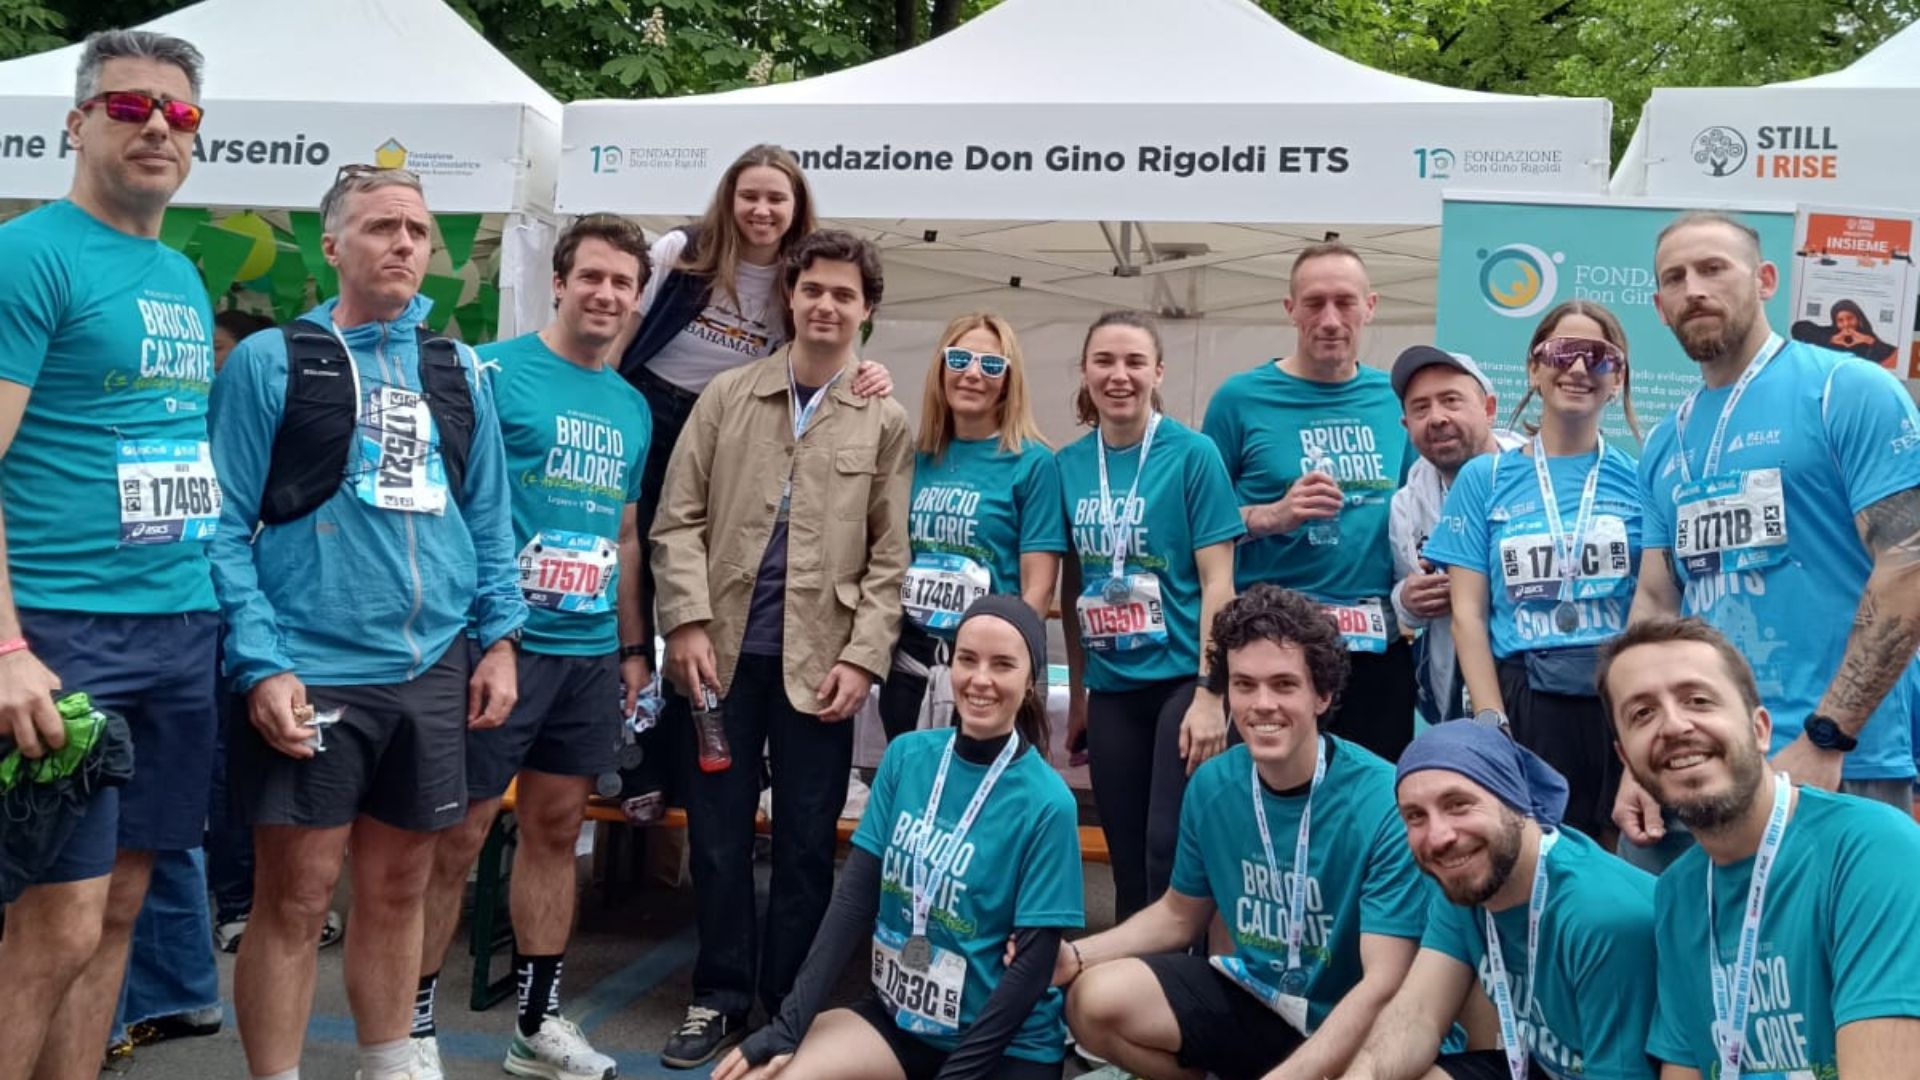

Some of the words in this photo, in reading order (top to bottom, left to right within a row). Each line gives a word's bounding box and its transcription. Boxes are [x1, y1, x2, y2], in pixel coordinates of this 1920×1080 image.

[628, 147, 707, 159] FONDAZIONE
[1757, 126, 1838, 150] STILL
[790, 144, 954, 172] ondazione
[965, 146, 1034, 172] Don
[1044, 145, 1126, 173] Gino
[1138, 145, 1267, 178] Rigoldi
[1279, 146, 1349, 174] ETS
[1463, 151, 1563, 163] FONDAZIONE
[1463, 163, 1488, 173] Don
[1489, 163, 1518, 173] Gino
[1520, 163, 1562, 175] Rigoldi
[1756, 155, 1765, 178] I
[1773, 155, 1837, 178] RISE
[1826, 237, 1889, 253] INSIEME
[137, 298, 205, 342] BRUCIO
[684, 322, 759, 358] BAHAMAS
[140, 338, 211, 383] CALORIE
[377, 413, 418, 489] 1752A
[556, 414, 624, 458] BRUCIO
[1299, 425, 1376, 456] BRUCIO
[544, 446, 626, 490] CALORIE
[1300, 453, 1388, 482] CORIE
[148, 476, 212, 518] 1746B
[912, 486, 982, 517] BRUCIO
[1074, 496, 1146, 526] BRUCO
[1694, 508, 1753, 551] 1771B
[1527, 543, 1599, 579] 17C
[916, 577, 966, 613] 1746A
[892, 810, 975, 878] BRUCO
[882, 845, 967, 918] CALIE
[1241, 859, 1324, 913] BRUCO
[1236, 896, 1334, 948] CALOIE
[885, 957, 940, 1017] 1763C
